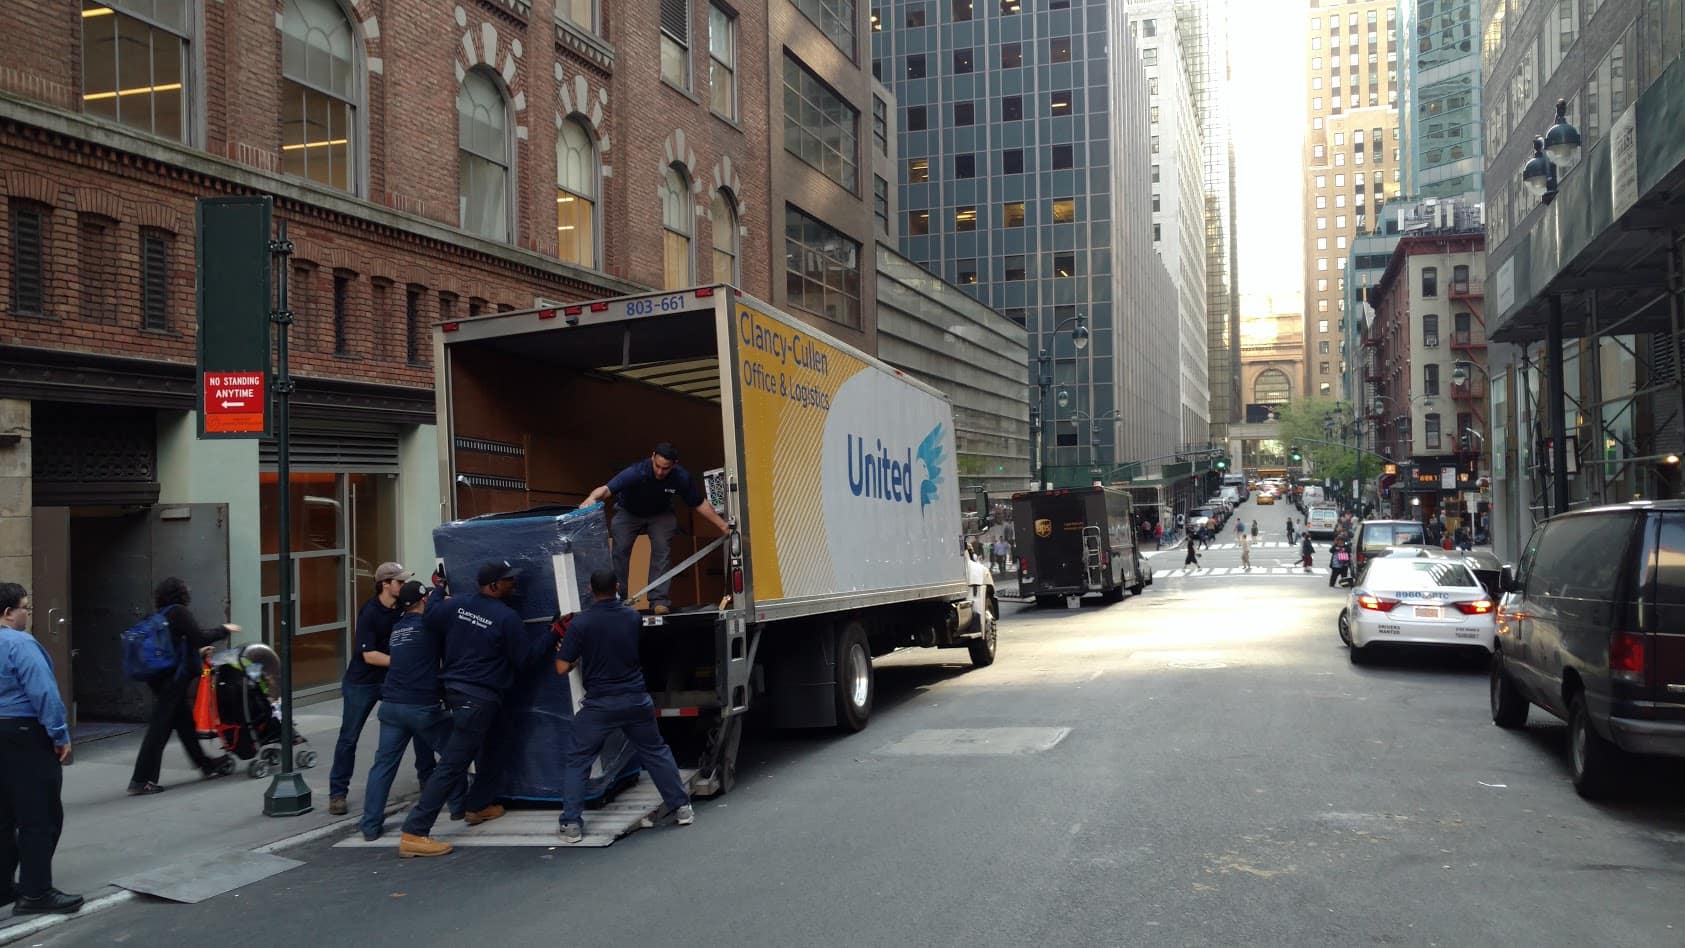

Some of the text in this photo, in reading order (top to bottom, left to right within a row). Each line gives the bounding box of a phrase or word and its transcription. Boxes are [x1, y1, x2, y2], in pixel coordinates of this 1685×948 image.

[626, 295, 685, 316] 803-661
[740, 311, 828, 376] Clancy-Cullen
[209, 376, 260, 386] NO STANDING
[215, 388, 255, 398] ANYTIME
[743, 360, 830, 410] Office & Logistics
[847, 433, 913, 504] United
